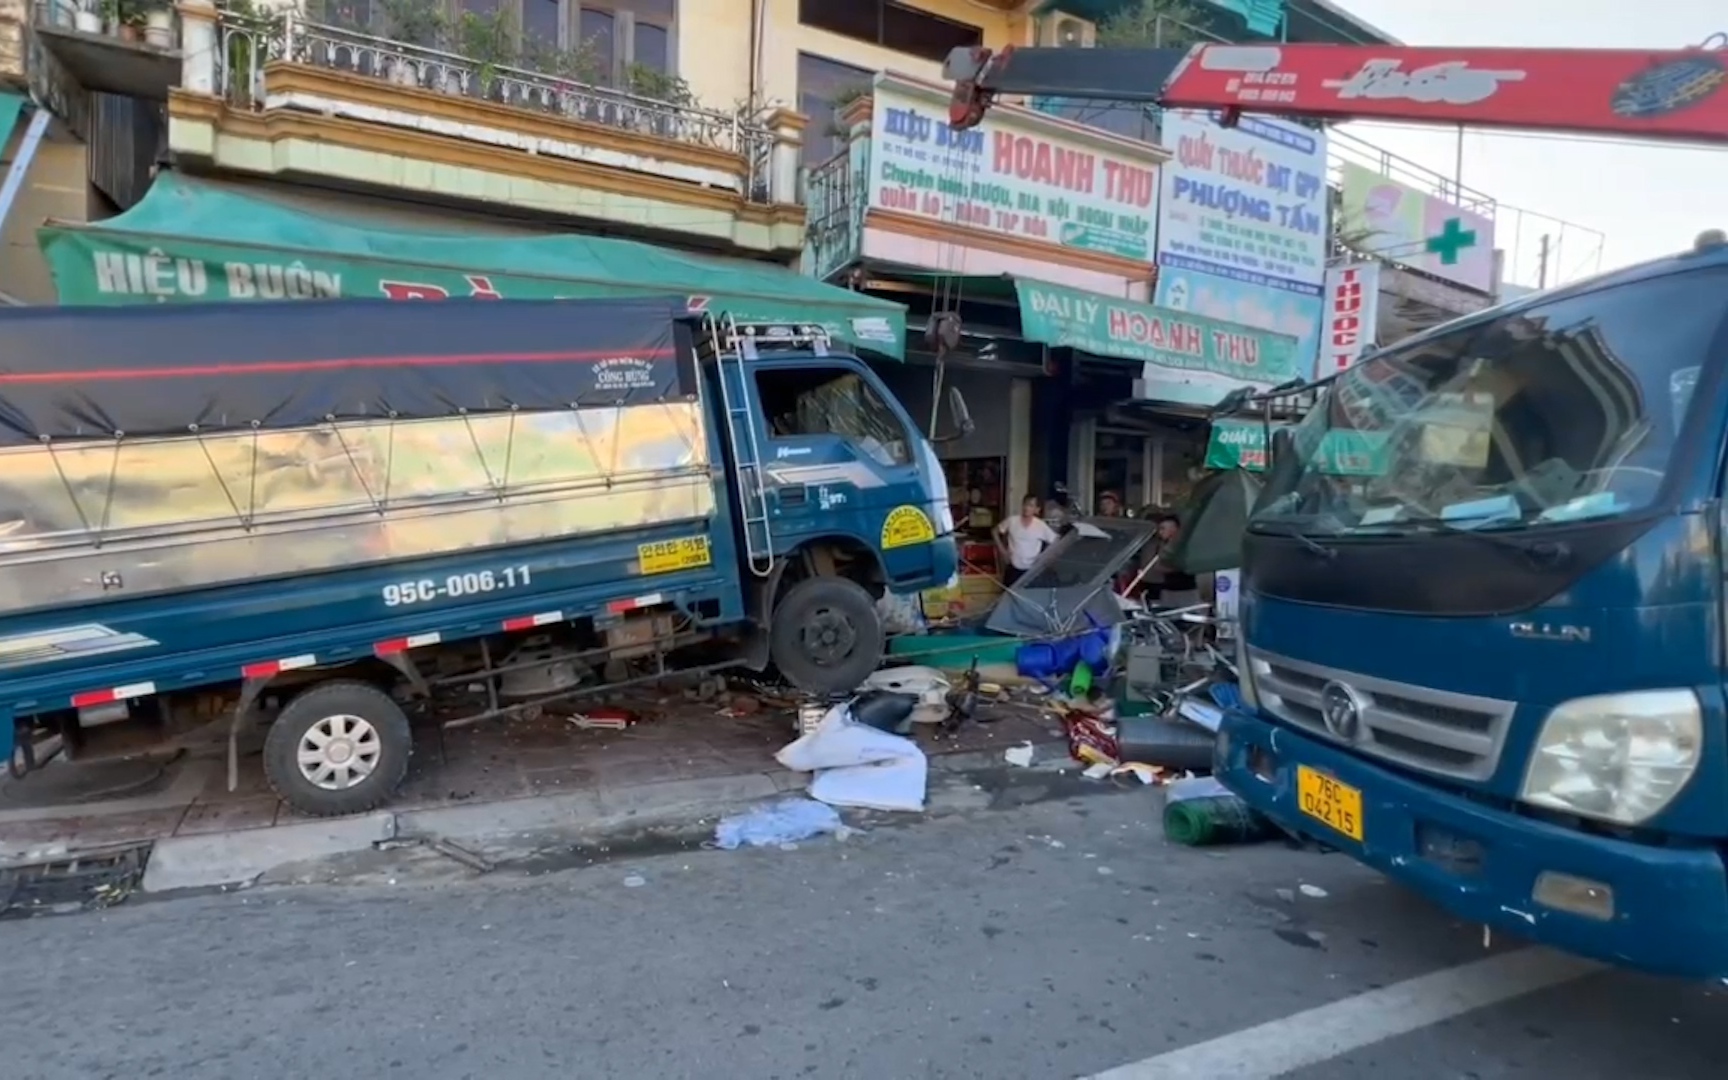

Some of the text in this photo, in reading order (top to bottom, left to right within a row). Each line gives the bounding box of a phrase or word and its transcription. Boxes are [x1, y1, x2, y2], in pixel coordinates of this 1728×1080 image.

[883, 107, 931, 142] HIỆU
[881, 161, 934, 189] Chuyên
[992, 129, 1095, 194] HOANH
[1102, 159, 1154, 209] THU
[92, 246, 209, 304] HIỆU
[223, 258, 343, 300] BUÔN
[1074, 297, 1100, 325] LÝ
[1107, 305, 1202, 357] HOANH
[1212, 328, 1260, 366] THU
[382, 565, 532, 607] 95C-006.11
[1316, 775, 1342, 804] 76C
